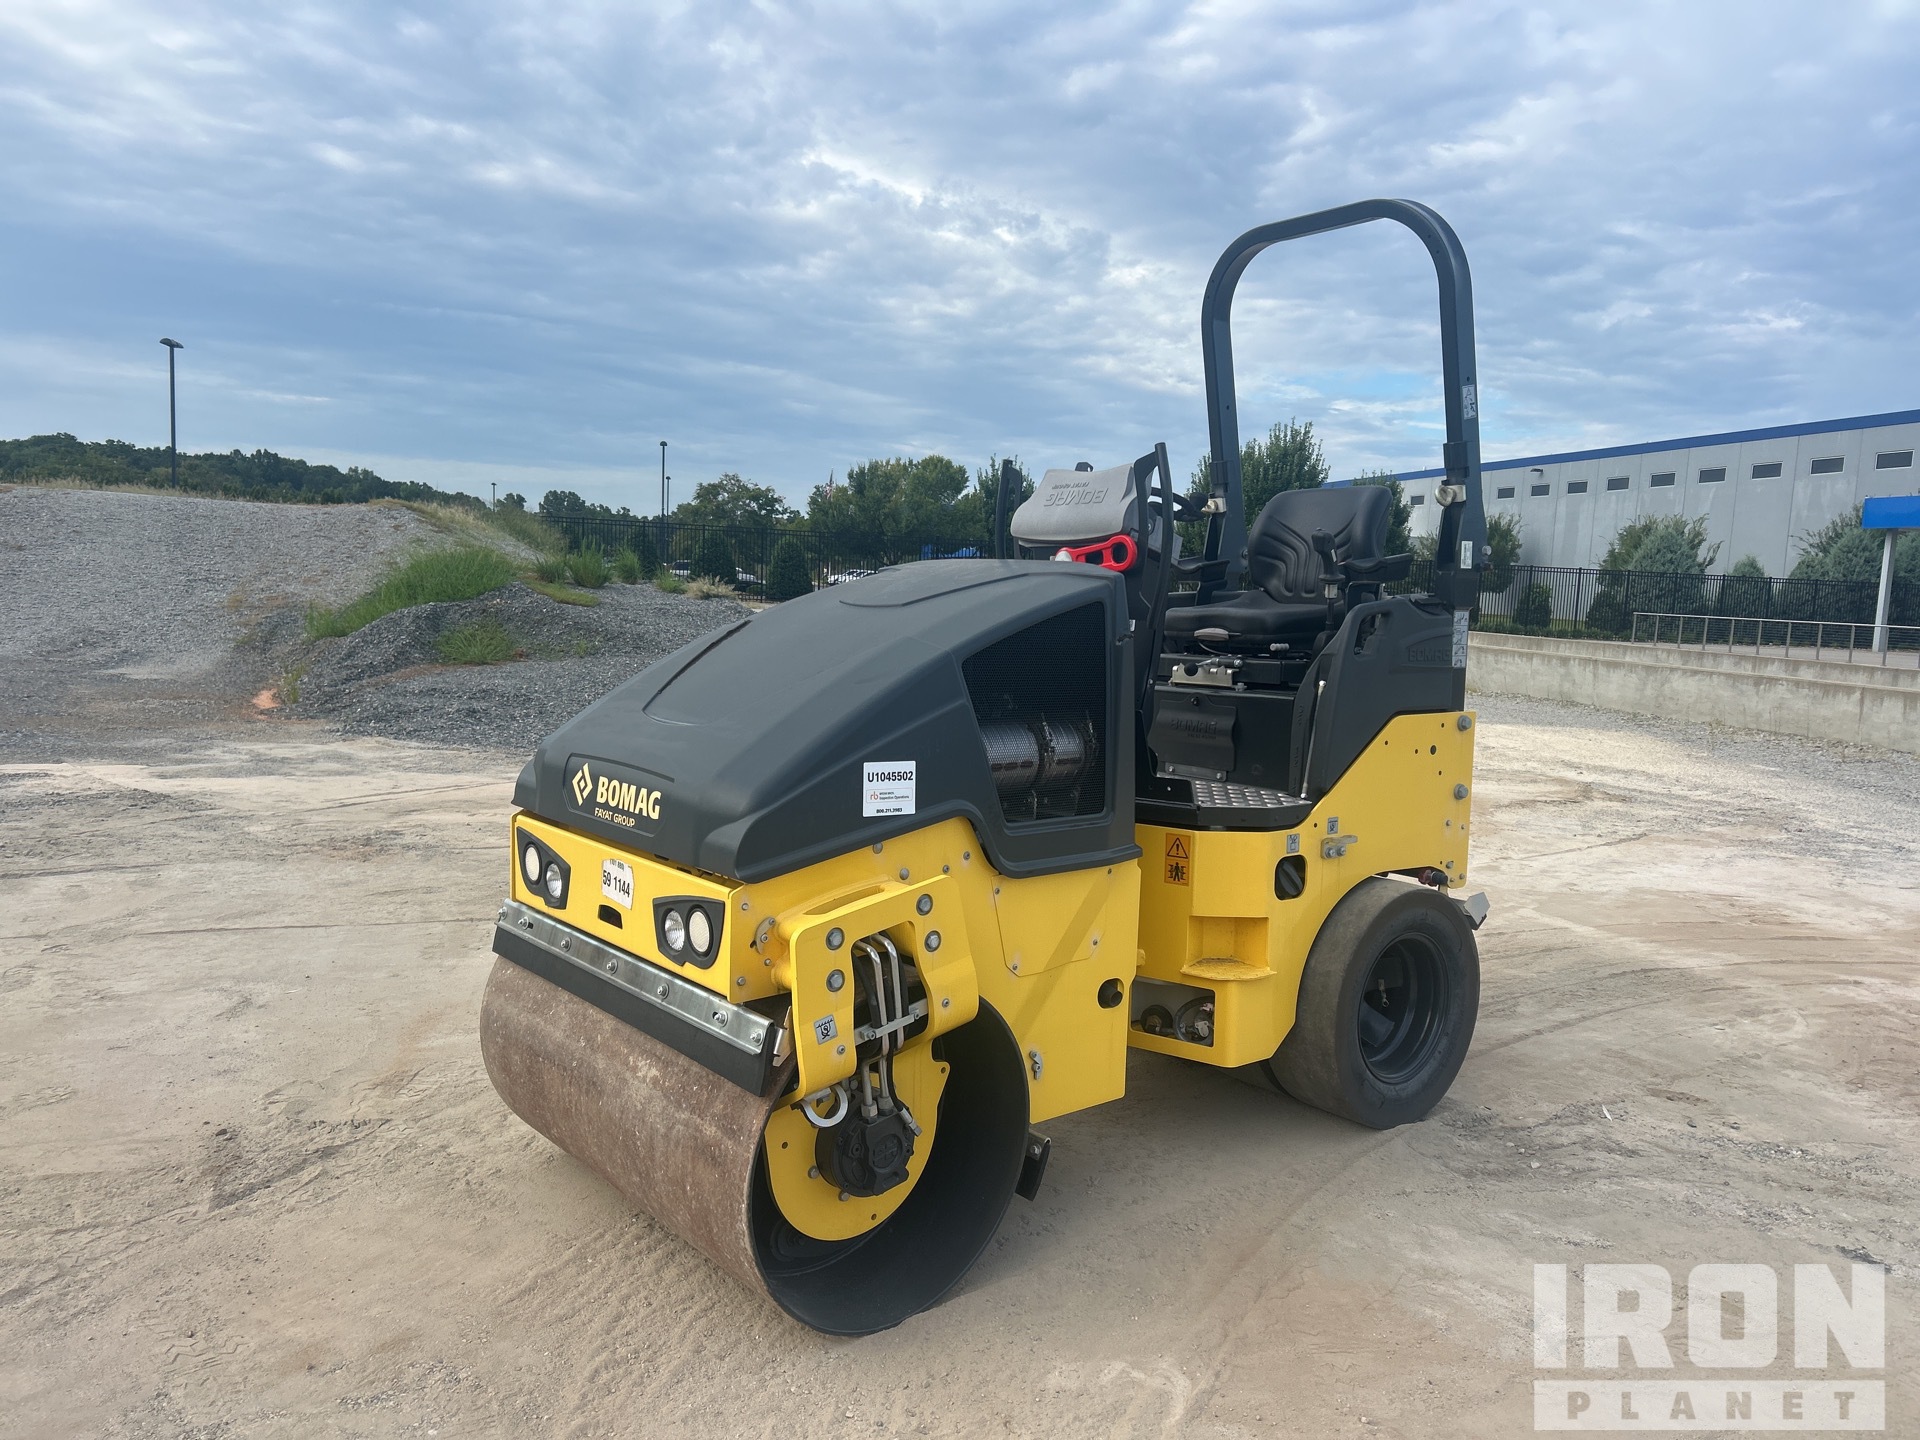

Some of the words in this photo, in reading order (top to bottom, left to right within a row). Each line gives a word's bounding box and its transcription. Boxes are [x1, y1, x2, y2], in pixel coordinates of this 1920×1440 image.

[1044, 488, 1109, 507] BOMAG
[1408, 648, 1451, 662] BOMAG
[867, 771, 913, 782] U1045502
[596, 776, 661, 820] BOMAG
[594, 807, 613, 821] FAYAT
[613, 813, 635, 827] GROUP
[602, 869, 611, 887] 59
[613, 876, 630, 898] 1144
